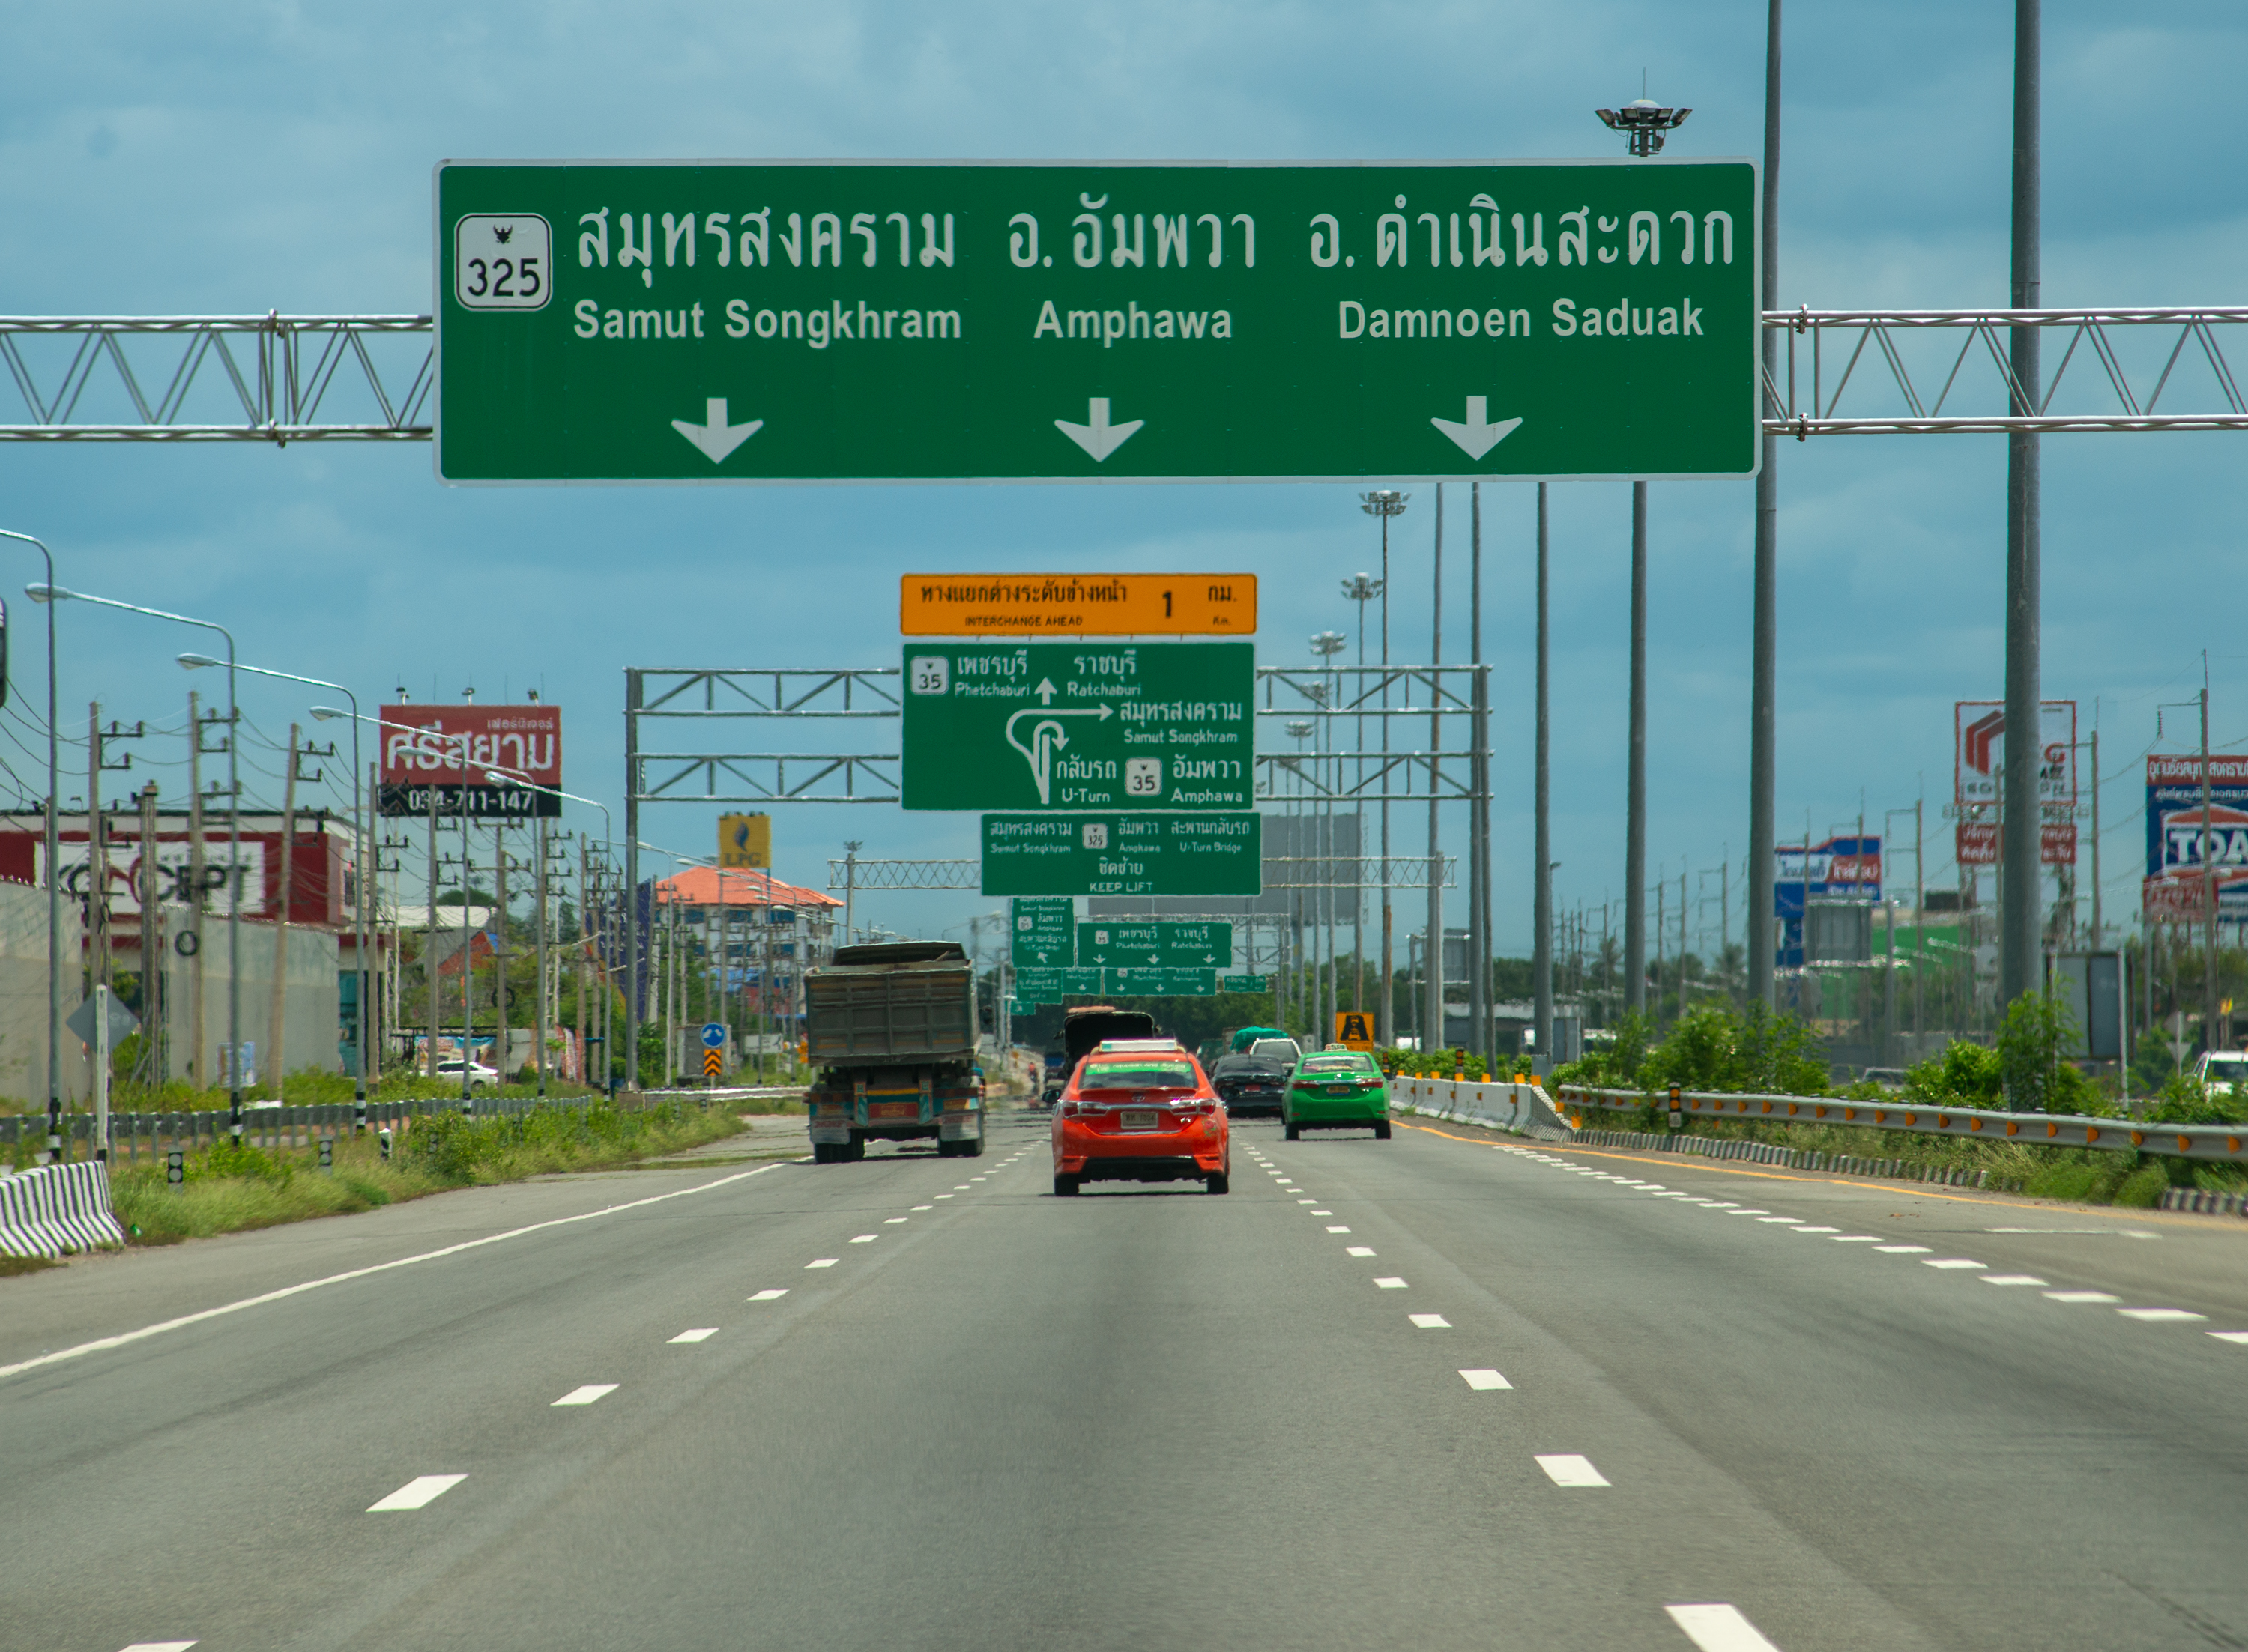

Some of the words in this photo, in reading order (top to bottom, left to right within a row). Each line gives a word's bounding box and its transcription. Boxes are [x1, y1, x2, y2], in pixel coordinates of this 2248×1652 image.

[578, 206, 954, 288] สมุทรสงคราม
[468, 258, 540, 297] 325
[574, 299, 704, 339] Samut
[725, 299, 961, 349] Songkhram
[1033, 300, 1232, 348] Amphawa
[1339, 300, 1530, 339] Damnoen
[1551, 297, 1704, 337] Saduak
[920, 580, 1128, 604] ทางแยกต่างระดับข้างหน้า
[1161, 590, 1173, 619] 1
[964, 616, 1042, 627] INTERCHANGE
[1045, 615, 1084, 626] AHEAD
[957, 649, 1027, 683] เพชรบุรี
[1073, 649, 1137, 683] ราชบุรี
[918, 674, 943, 691] 35
[955, 681, 1030, 697] Phetchaburi
[1067, 681, 1141, 697] Ratchaburi
[1120, 701, 1242, 727] สมุทรสงคราม
[1123, 729, 1164, 743] Samut
[1169, 729, 1238, 746] Songkhram
[1057, 754, 1117, 779] กลับรถ
[1173, 754, 1241, 778] อัมพวา
[1061, 787, 1111, 802] U-Turn
[1132, 775, 1156, 792] 35
[1170, 787, 1243, 804] Amphawa
[990, 821, 1072, 841] สมุทรสงคราม
[1118, 817, 1159, 835] อัมพวา
[2170, 829, 2248, 863] TOA
[725, 852, 762, 866] LPG
[1089, 882, 1123, 892] KEEP
